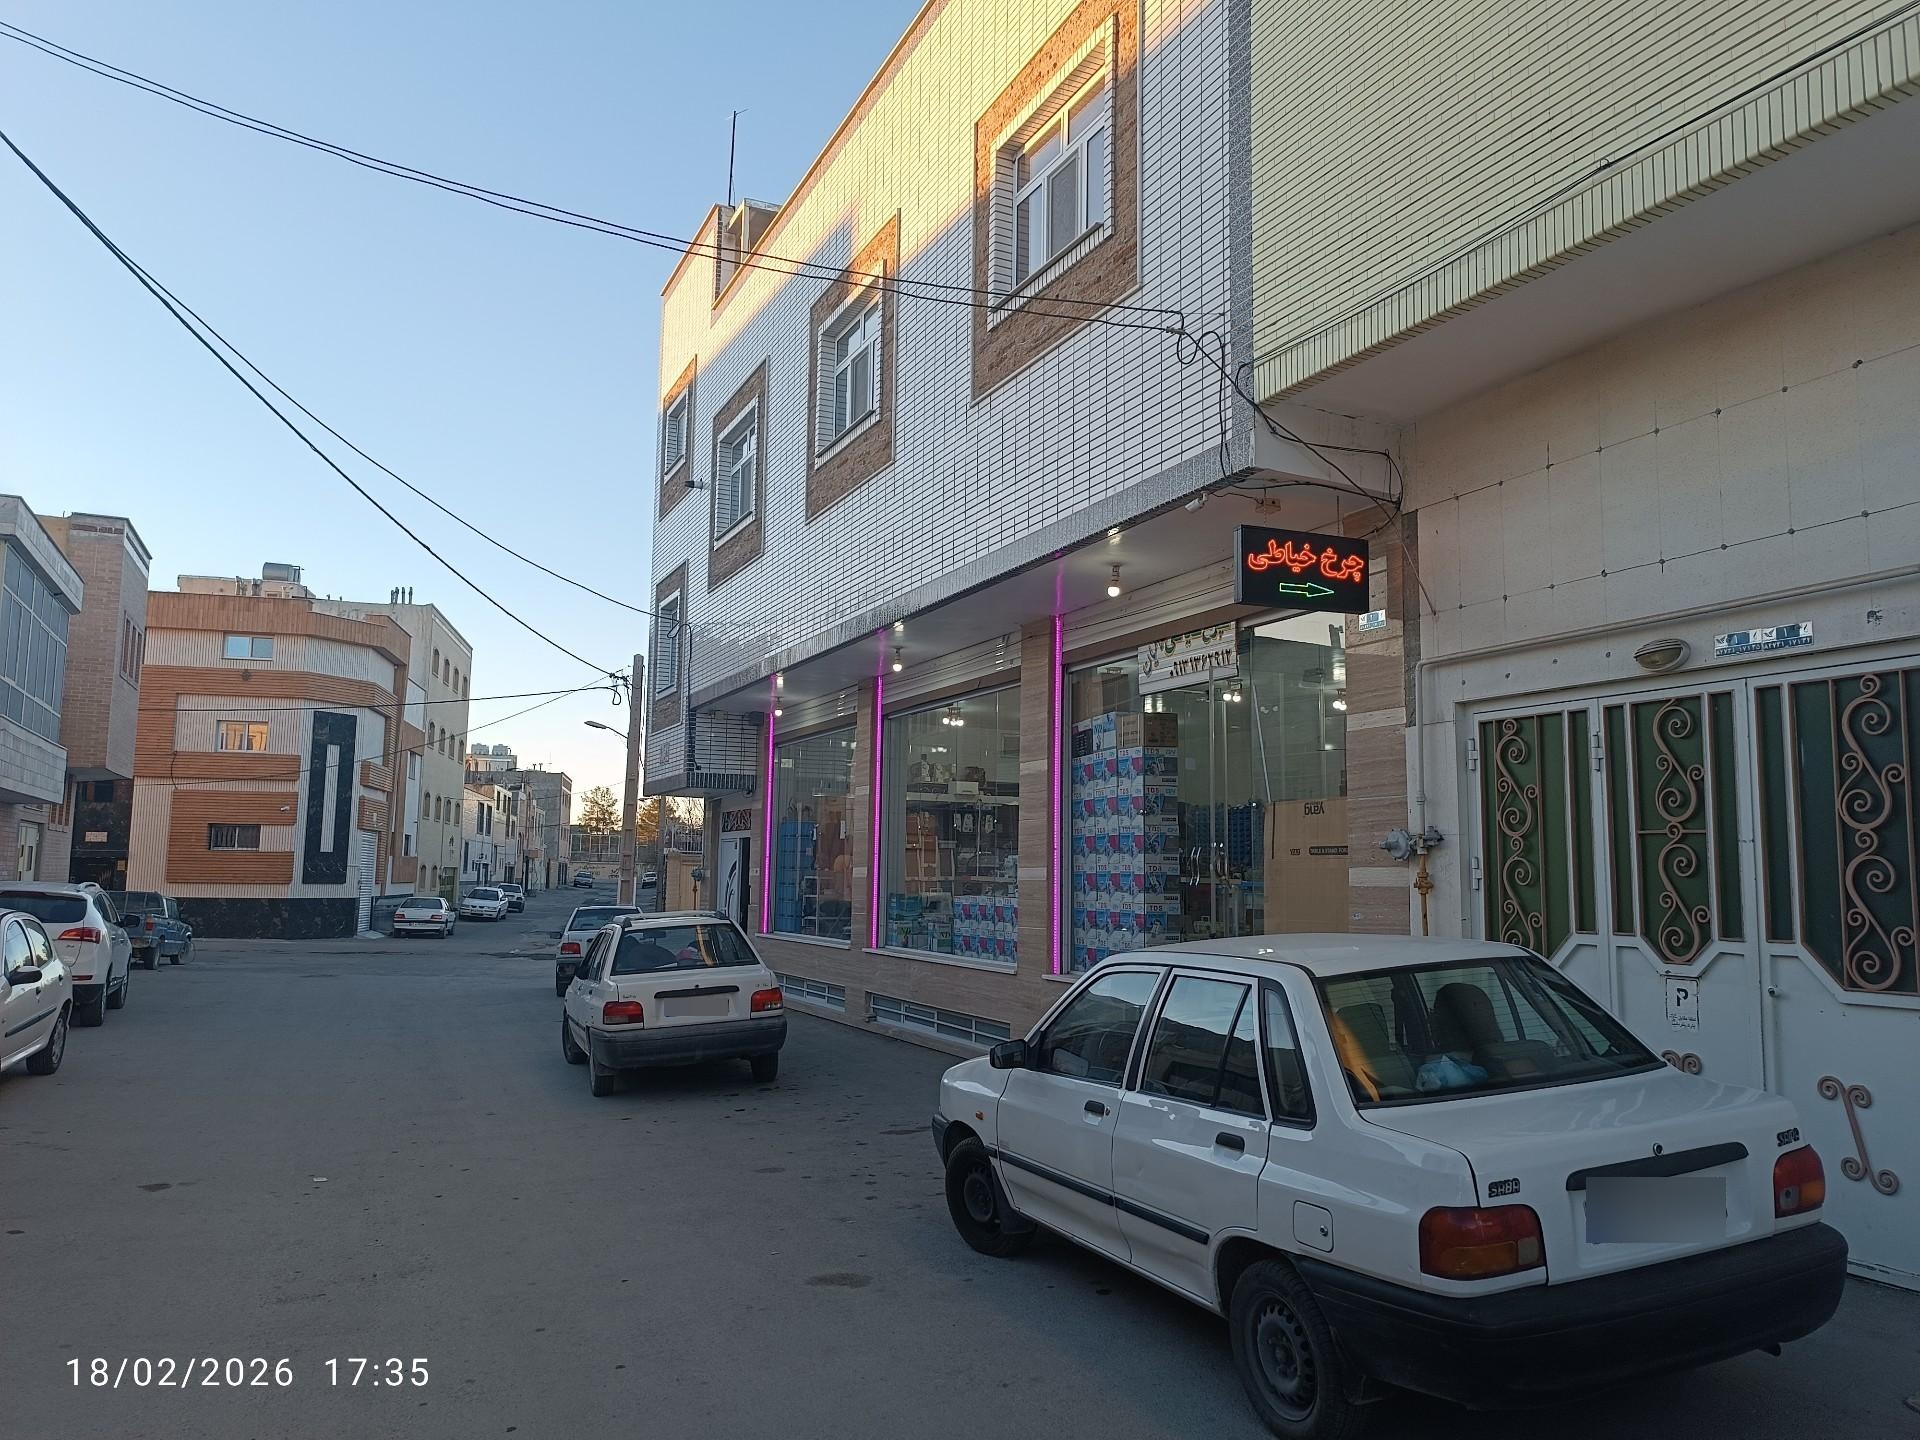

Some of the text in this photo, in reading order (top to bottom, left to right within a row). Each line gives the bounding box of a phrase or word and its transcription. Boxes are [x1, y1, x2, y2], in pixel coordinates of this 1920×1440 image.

[1248, 539, 1364, 582] چرخ خیاطی
[1676, 987, 1689, 1007] P
[1488, 1178, 1520, 1198] SABA
